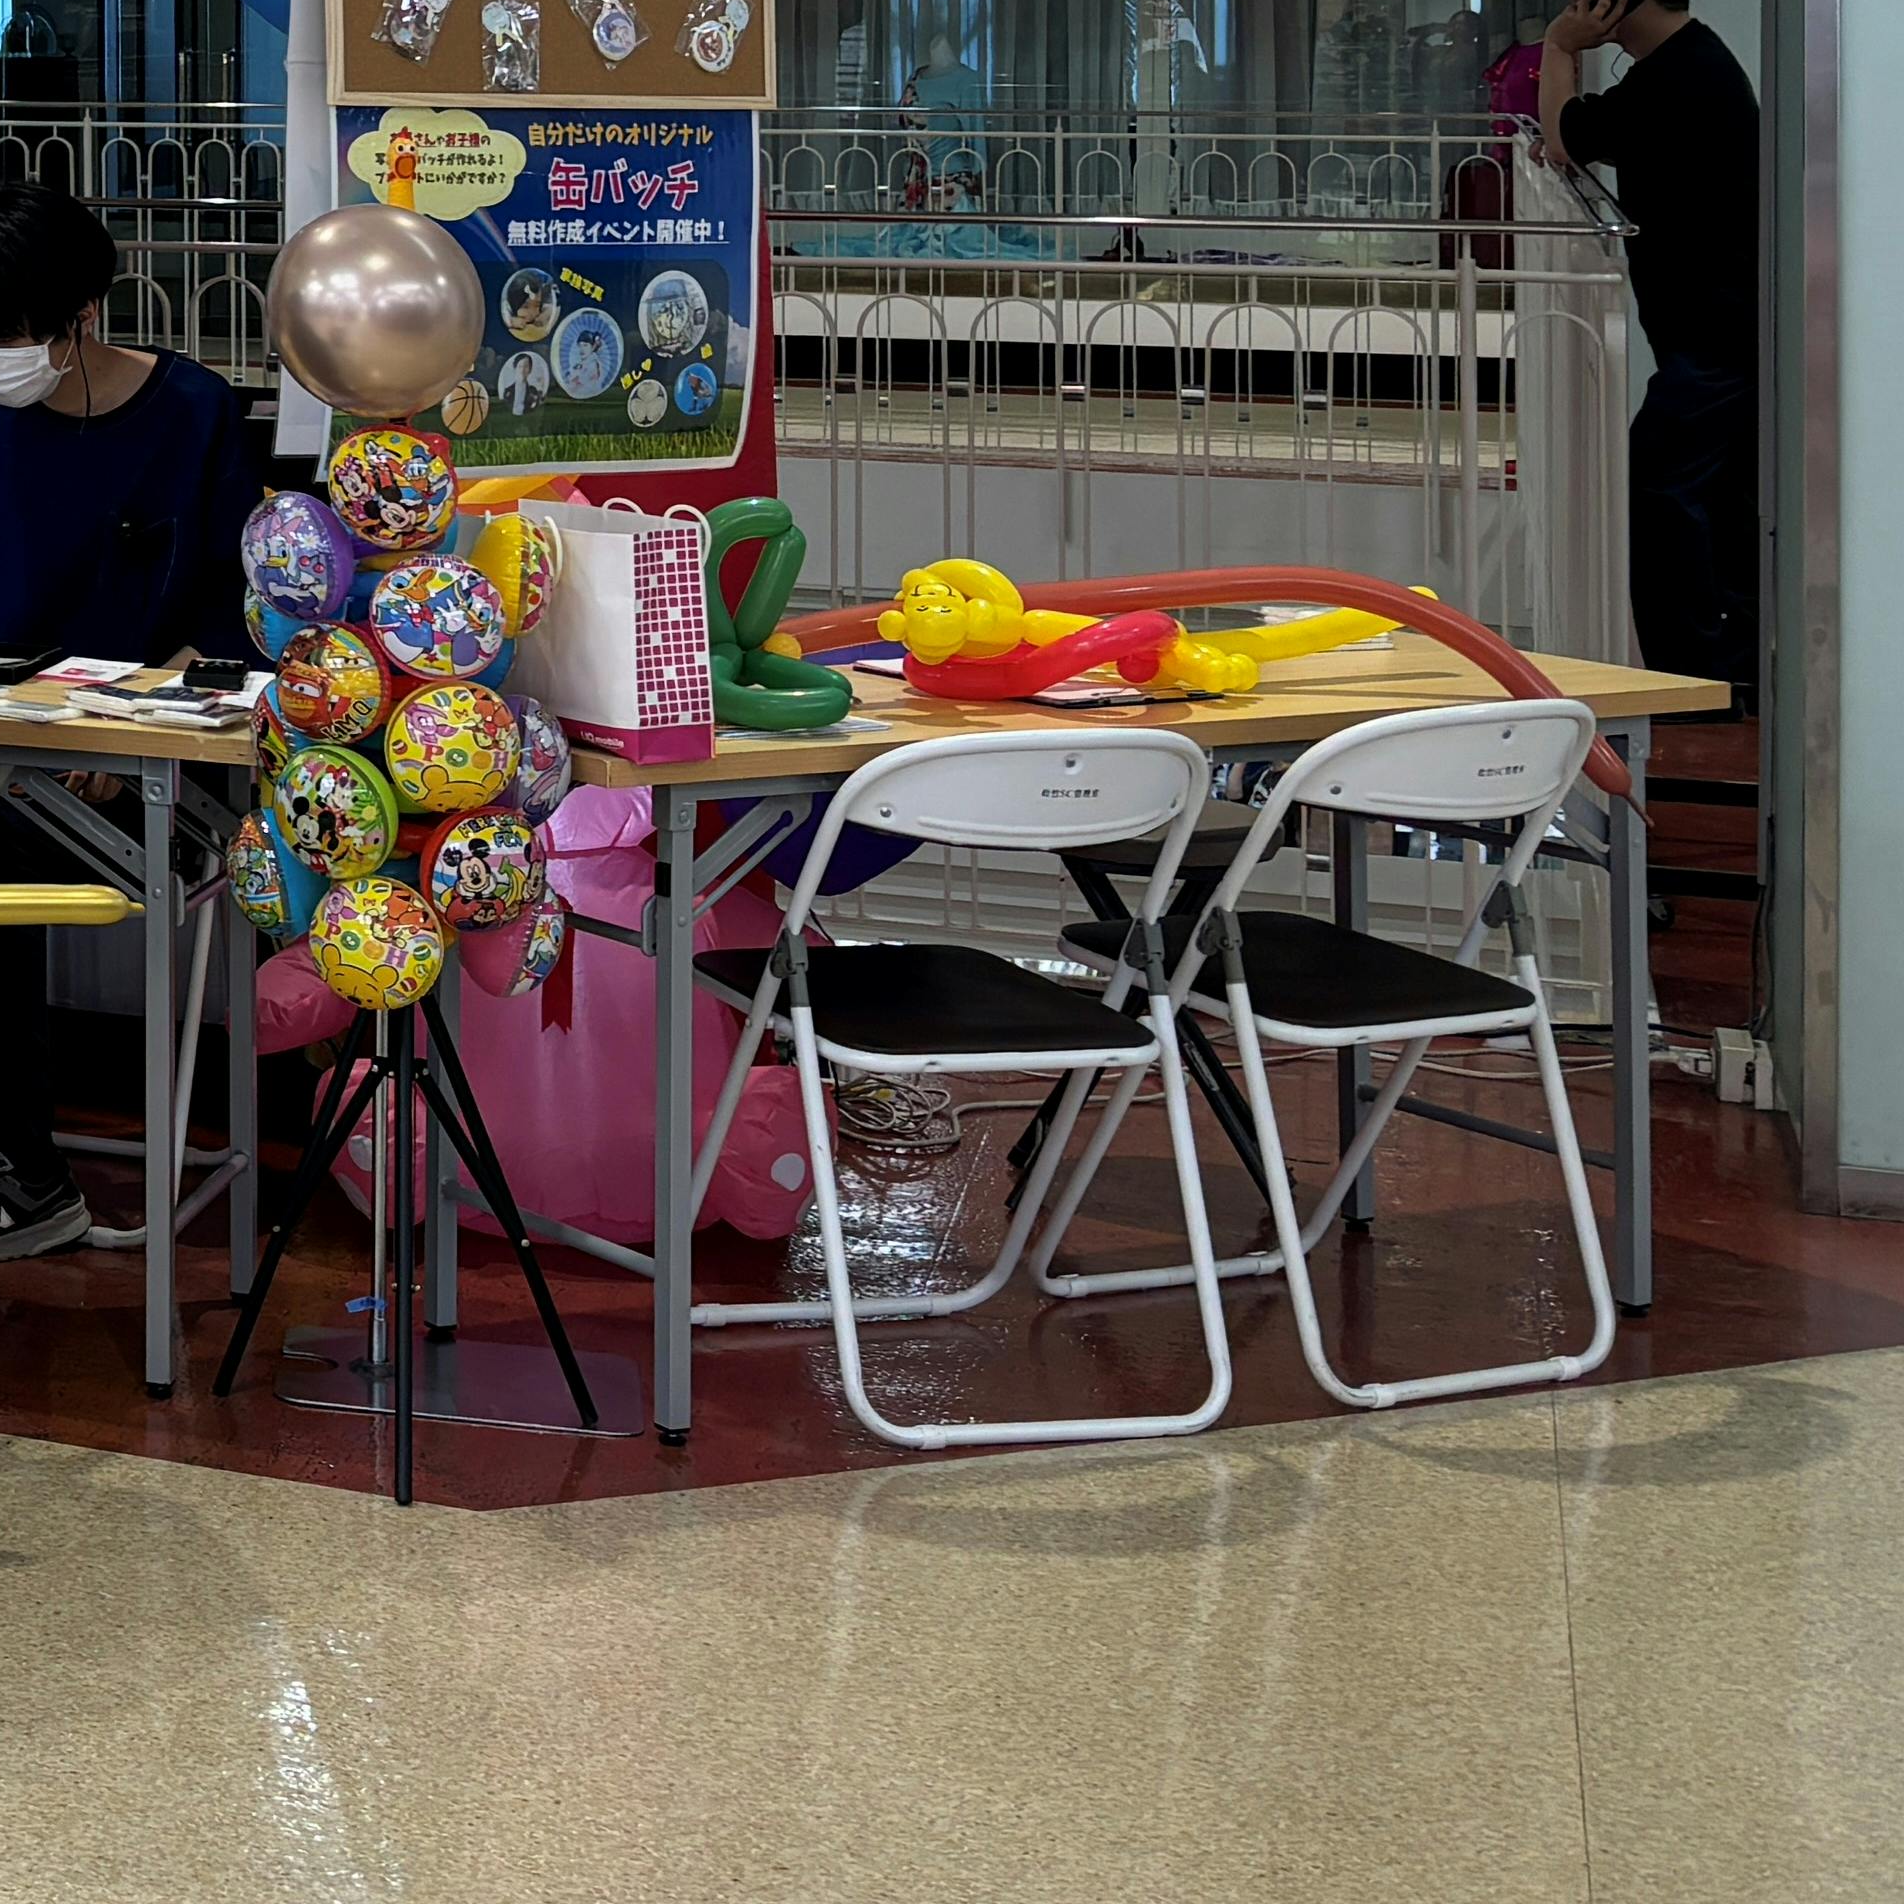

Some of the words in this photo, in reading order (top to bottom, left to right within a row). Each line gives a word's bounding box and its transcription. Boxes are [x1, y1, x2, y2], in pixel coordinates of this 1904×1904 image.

[527, 122, 715, 147] 自分だけのオリジナル
[548, 157, 698, 211] 缶バッチ
[507, 218, 726, 243] 無料作成イベント開催中！
